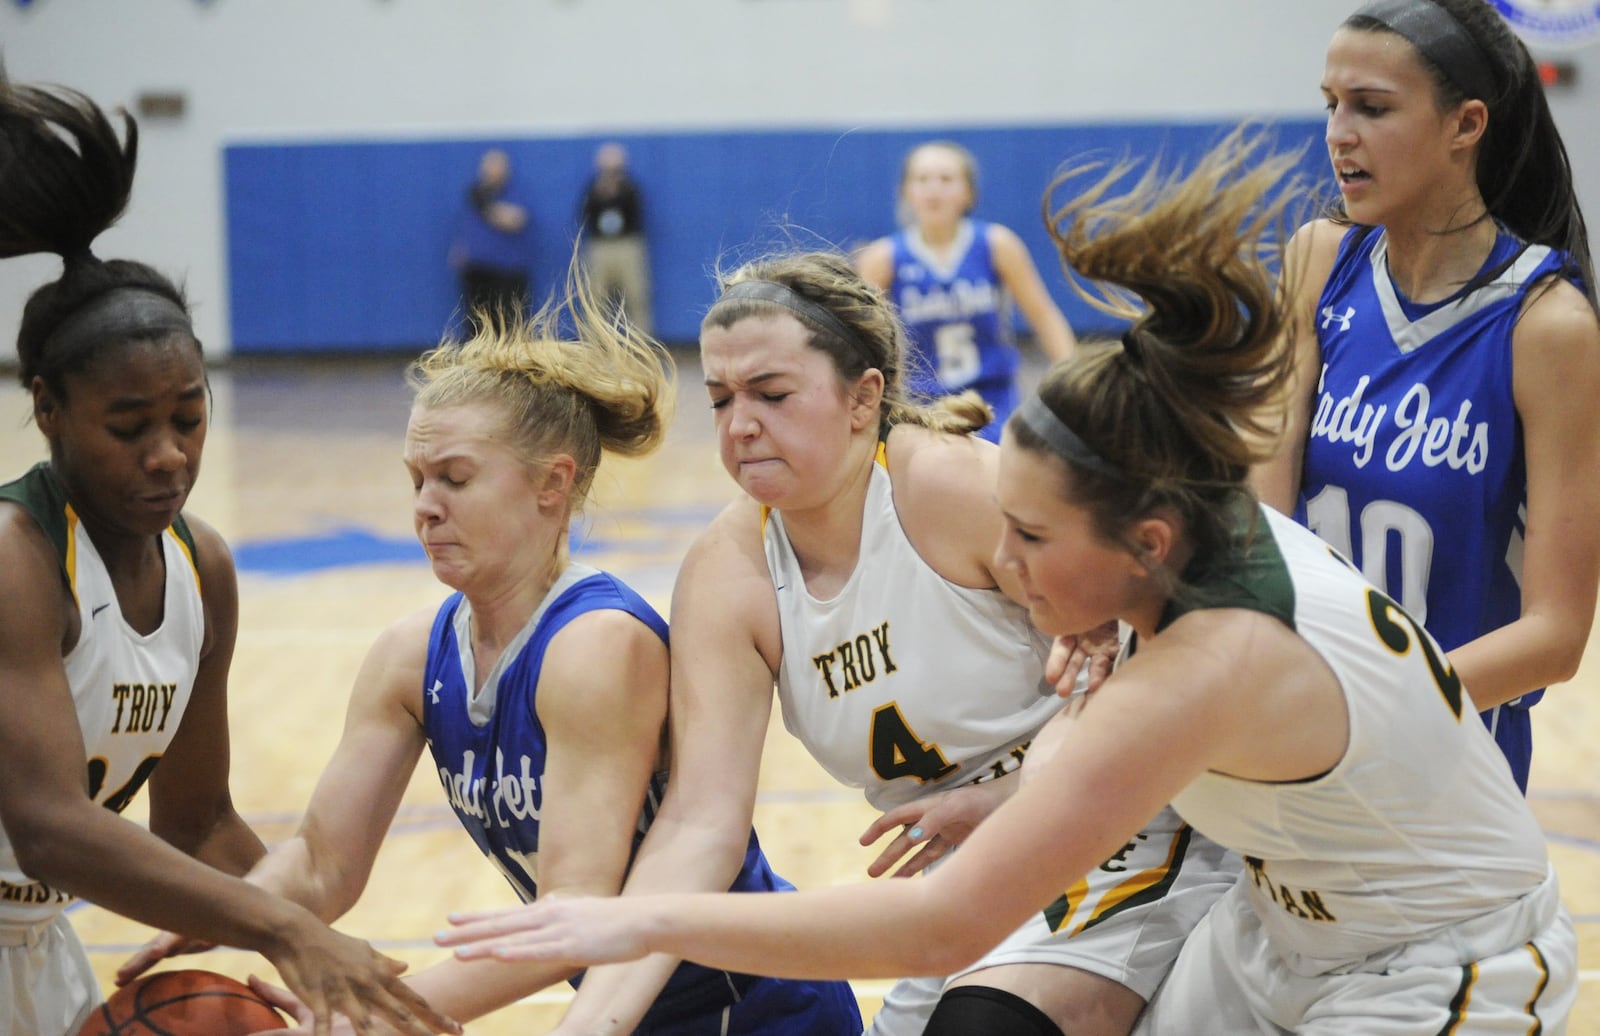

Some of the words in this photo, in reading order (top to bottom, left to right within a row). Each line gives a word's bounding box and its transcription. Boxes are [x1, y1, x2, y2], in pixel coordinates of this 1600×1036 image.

[1310, 362, 1387, 469] ady
[1386, 383, 1489, 475] Jets
[1306, 484, 1433, 628] 10
[813, 620, 898, 699] TROY
[111, 681, 177, 735] TROY
[869, 700, 961, 785] 4
